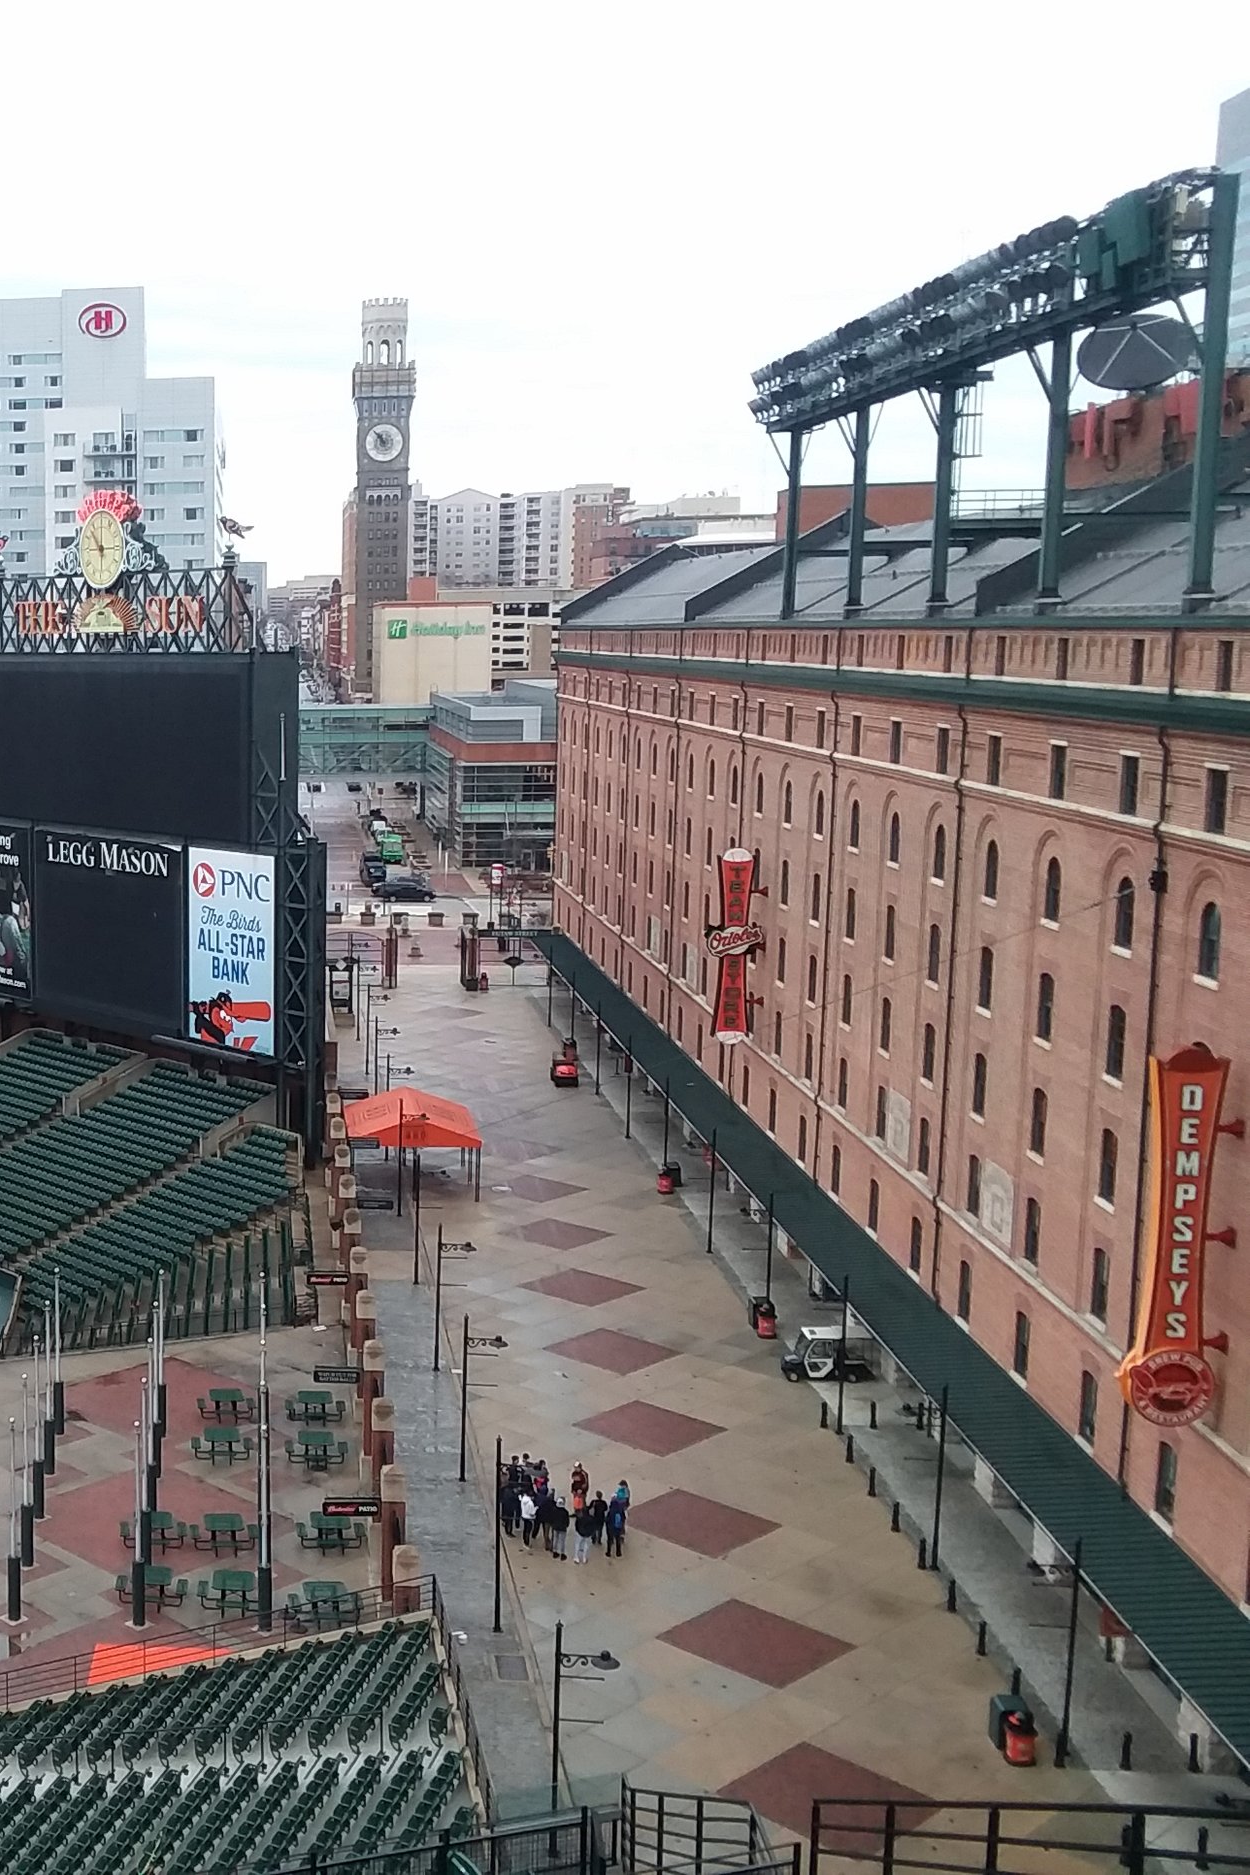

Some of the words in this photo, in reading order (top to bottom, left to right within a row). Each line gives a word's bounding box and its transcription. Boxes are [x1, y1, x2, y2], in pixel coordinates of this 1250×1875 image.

[13, 600, 67, 635] THE
[144, 595, 206, 634] SUN
[411, 622, 464, 636] Holiday
[464, 620, 486, 635] Inn
[47, 840, 95, 868] LEGG
[99, 842, 169, 877] MASON
[219, 869, 270, 902] PNC
[728, 866, 747, 922] TEAM
[201, 905, 224, 927] The
[226, 909, 262, 933] Birds
[198, 927, 266, 961] ALL-STAR
[710, 928, 761, 950] Orioles
[212, 956, 250, 985] BANK
[1166, 1085, 1203, 1338] DEMPSEYS
